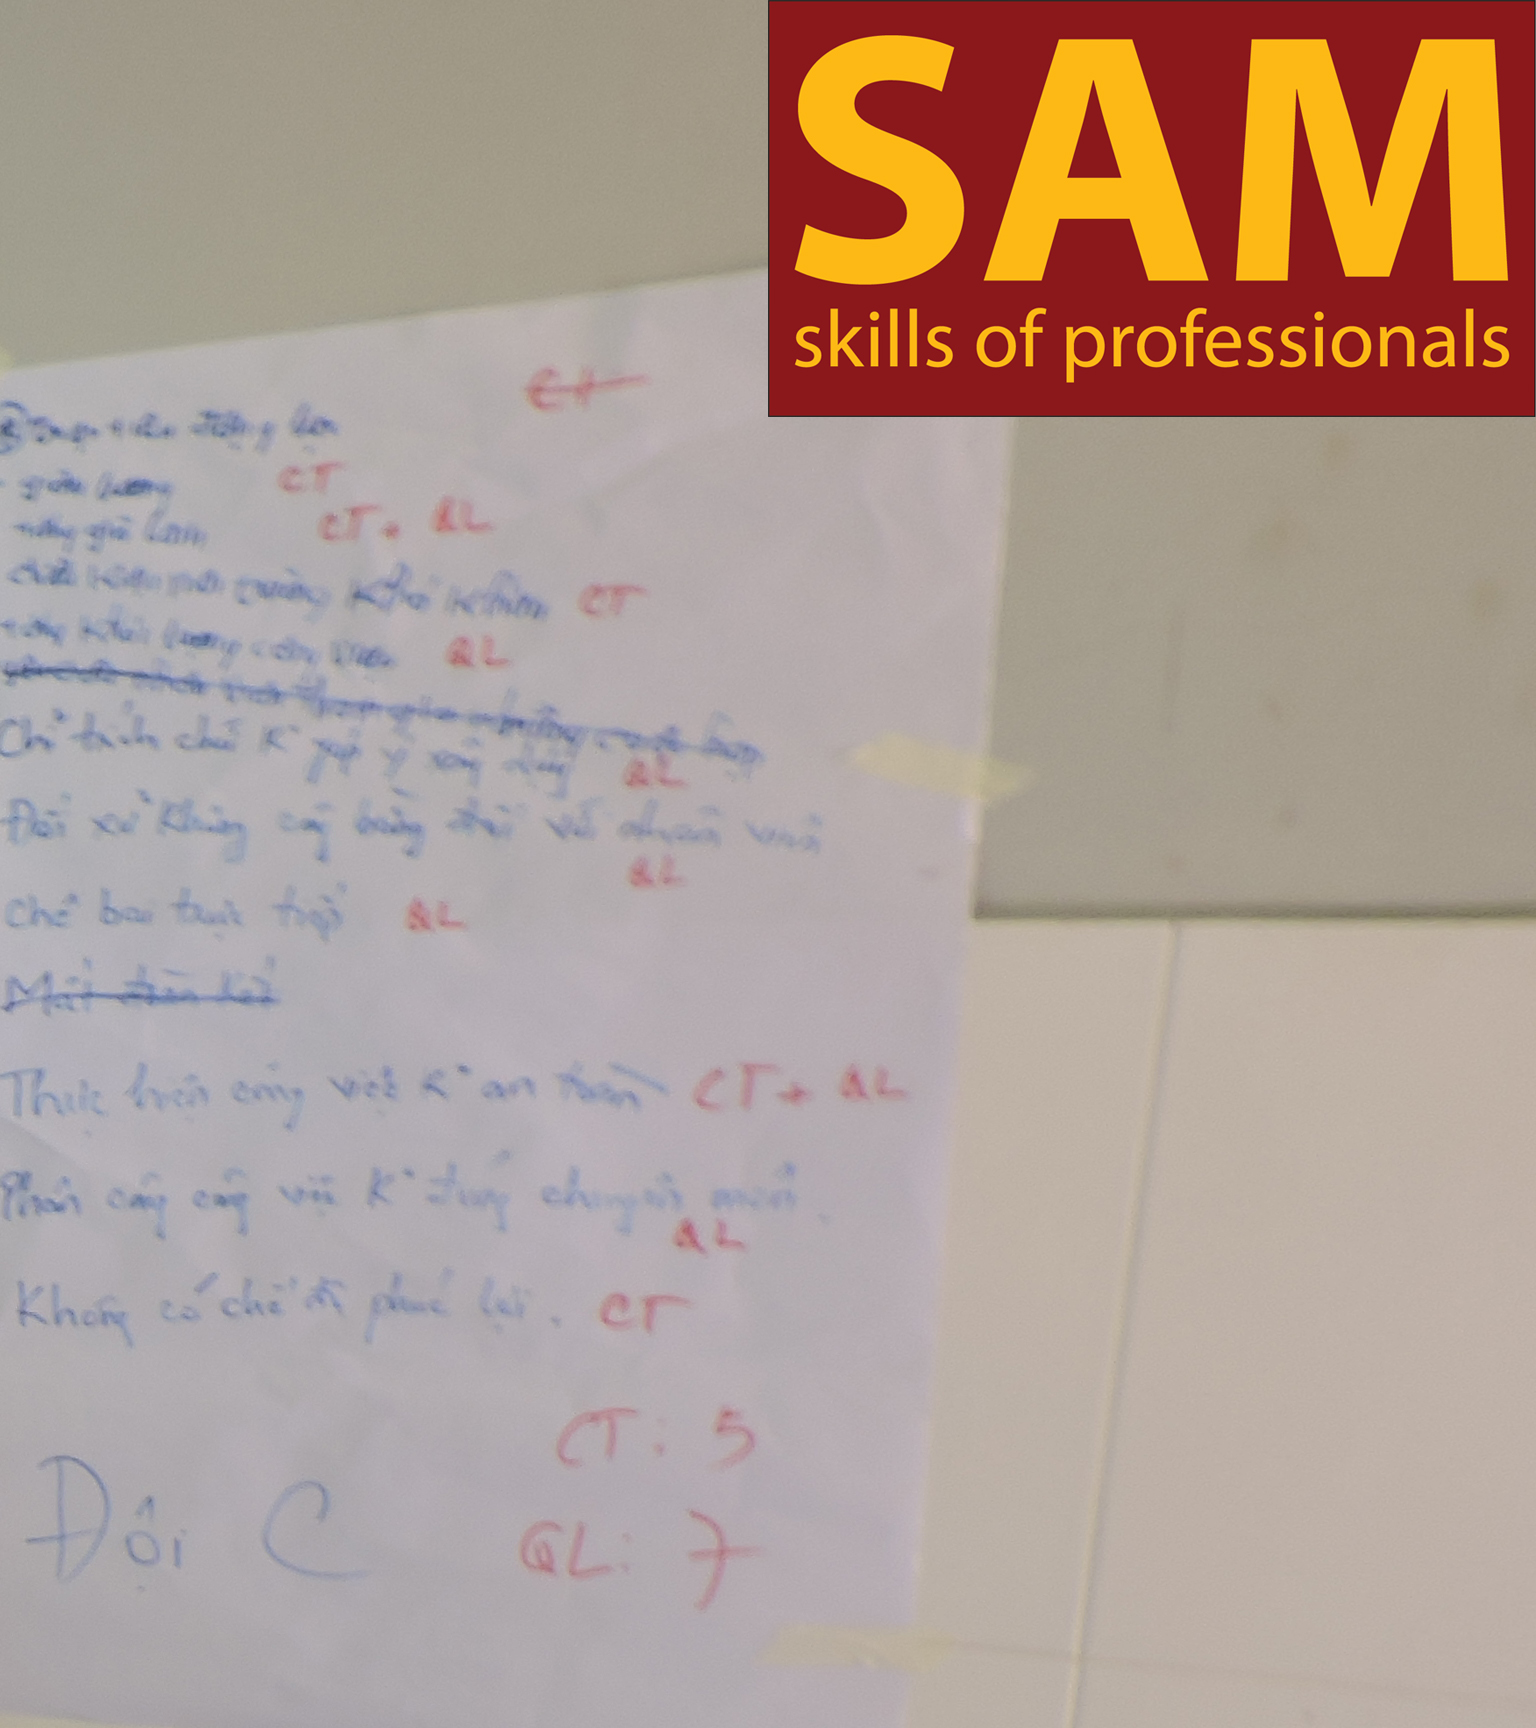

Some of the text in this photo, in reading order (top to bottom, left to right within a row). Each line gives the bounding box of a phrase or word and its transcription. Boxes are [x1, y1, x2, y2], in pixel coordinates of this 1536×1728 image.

[277, 461, 347, 493] CT
[317, 503, 381, 542] CT
[431, 495, 494, 535] QL
[577, 582, 650, 620] CT
[445, 634, 514, 669] QL
[623, 752, 690, 789] QL
[627, 853, 687, 889] QL
[405, 896, 468, 933] QL
[480, 1074, 537, 1101] an
[692, 1061, 781, 1112] CT
[839, 1062, 909, 1101] QL
[672, 1217, 746, 1256] QL
[599, 1292, 692, 1334] CT
[713, 1406, 756, 1467] 5
[262, 1480, 369, 1578] C
[689, 1509, 757, 1610] 7
